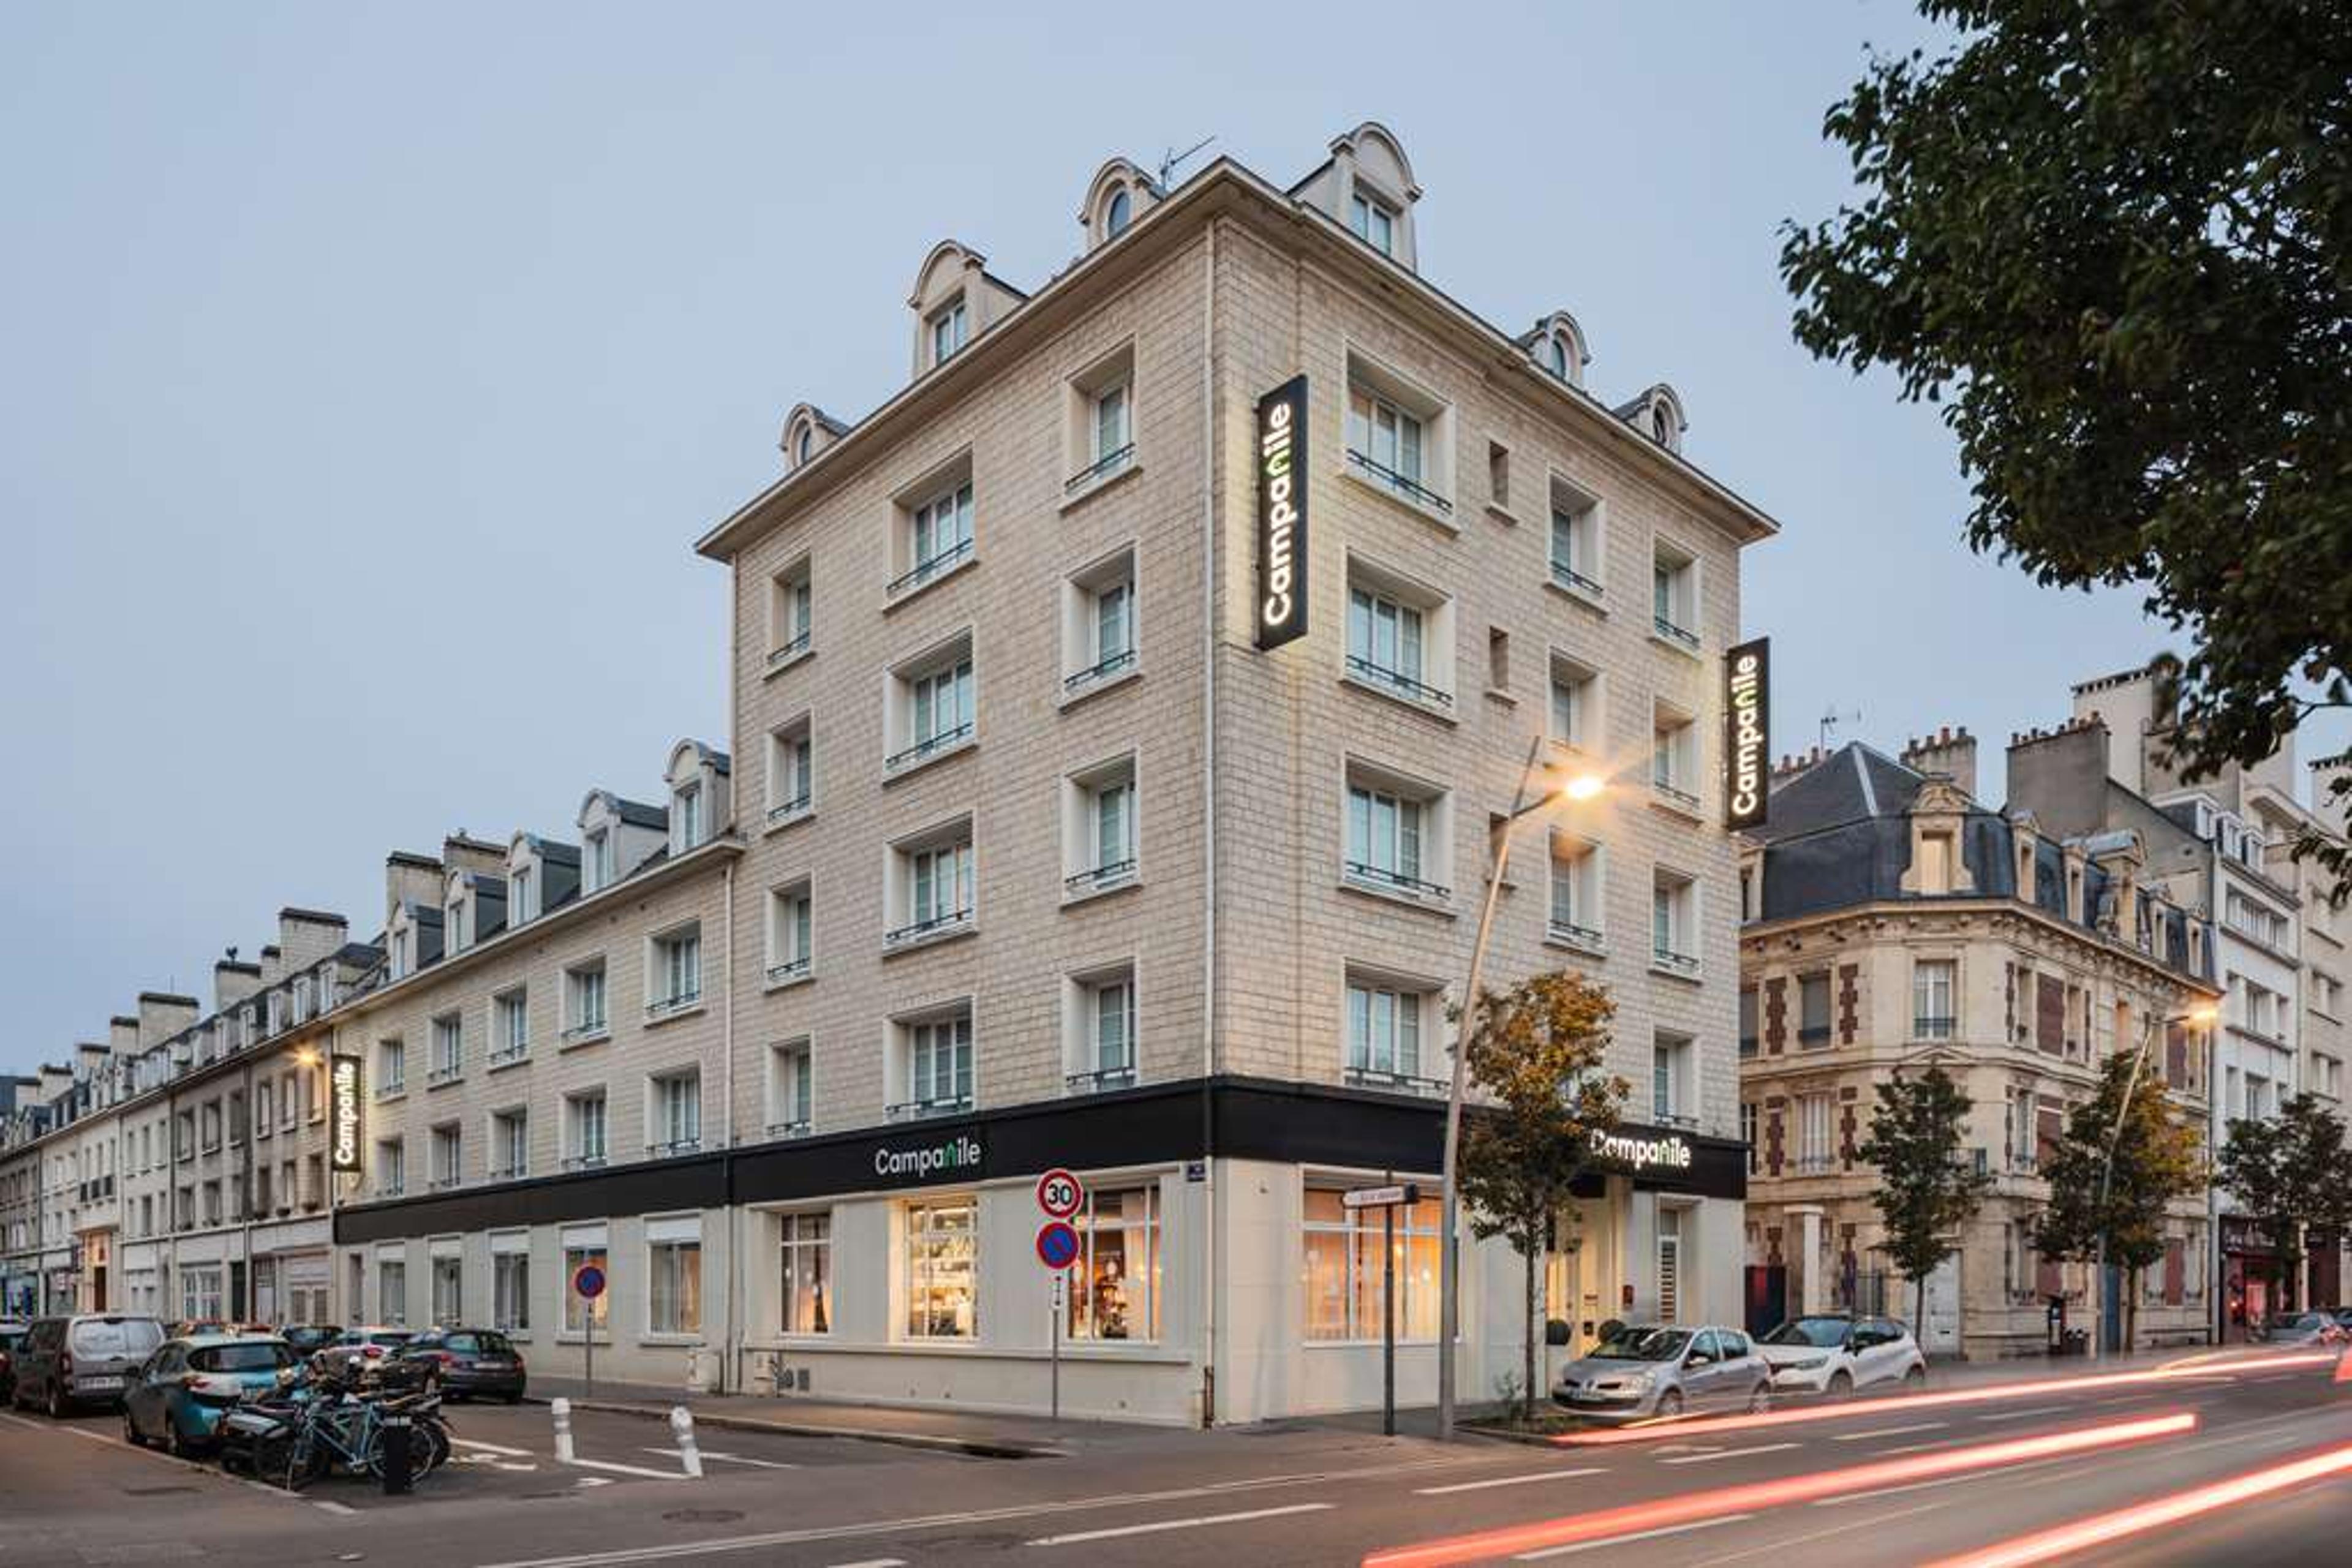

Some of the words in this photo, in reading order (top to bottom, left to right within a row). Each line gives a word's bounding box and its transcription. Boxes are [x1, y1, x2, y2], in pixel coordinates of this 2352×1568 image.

[1262, 402, 1298, 625] Campanile
[1731, 655, 1763, 815] Campanile
[334, 1063, 358, 1164] Campanile
[875, 1136, 981, 1178] Campanile
[1048, 1183, 1072, 1205] 30
